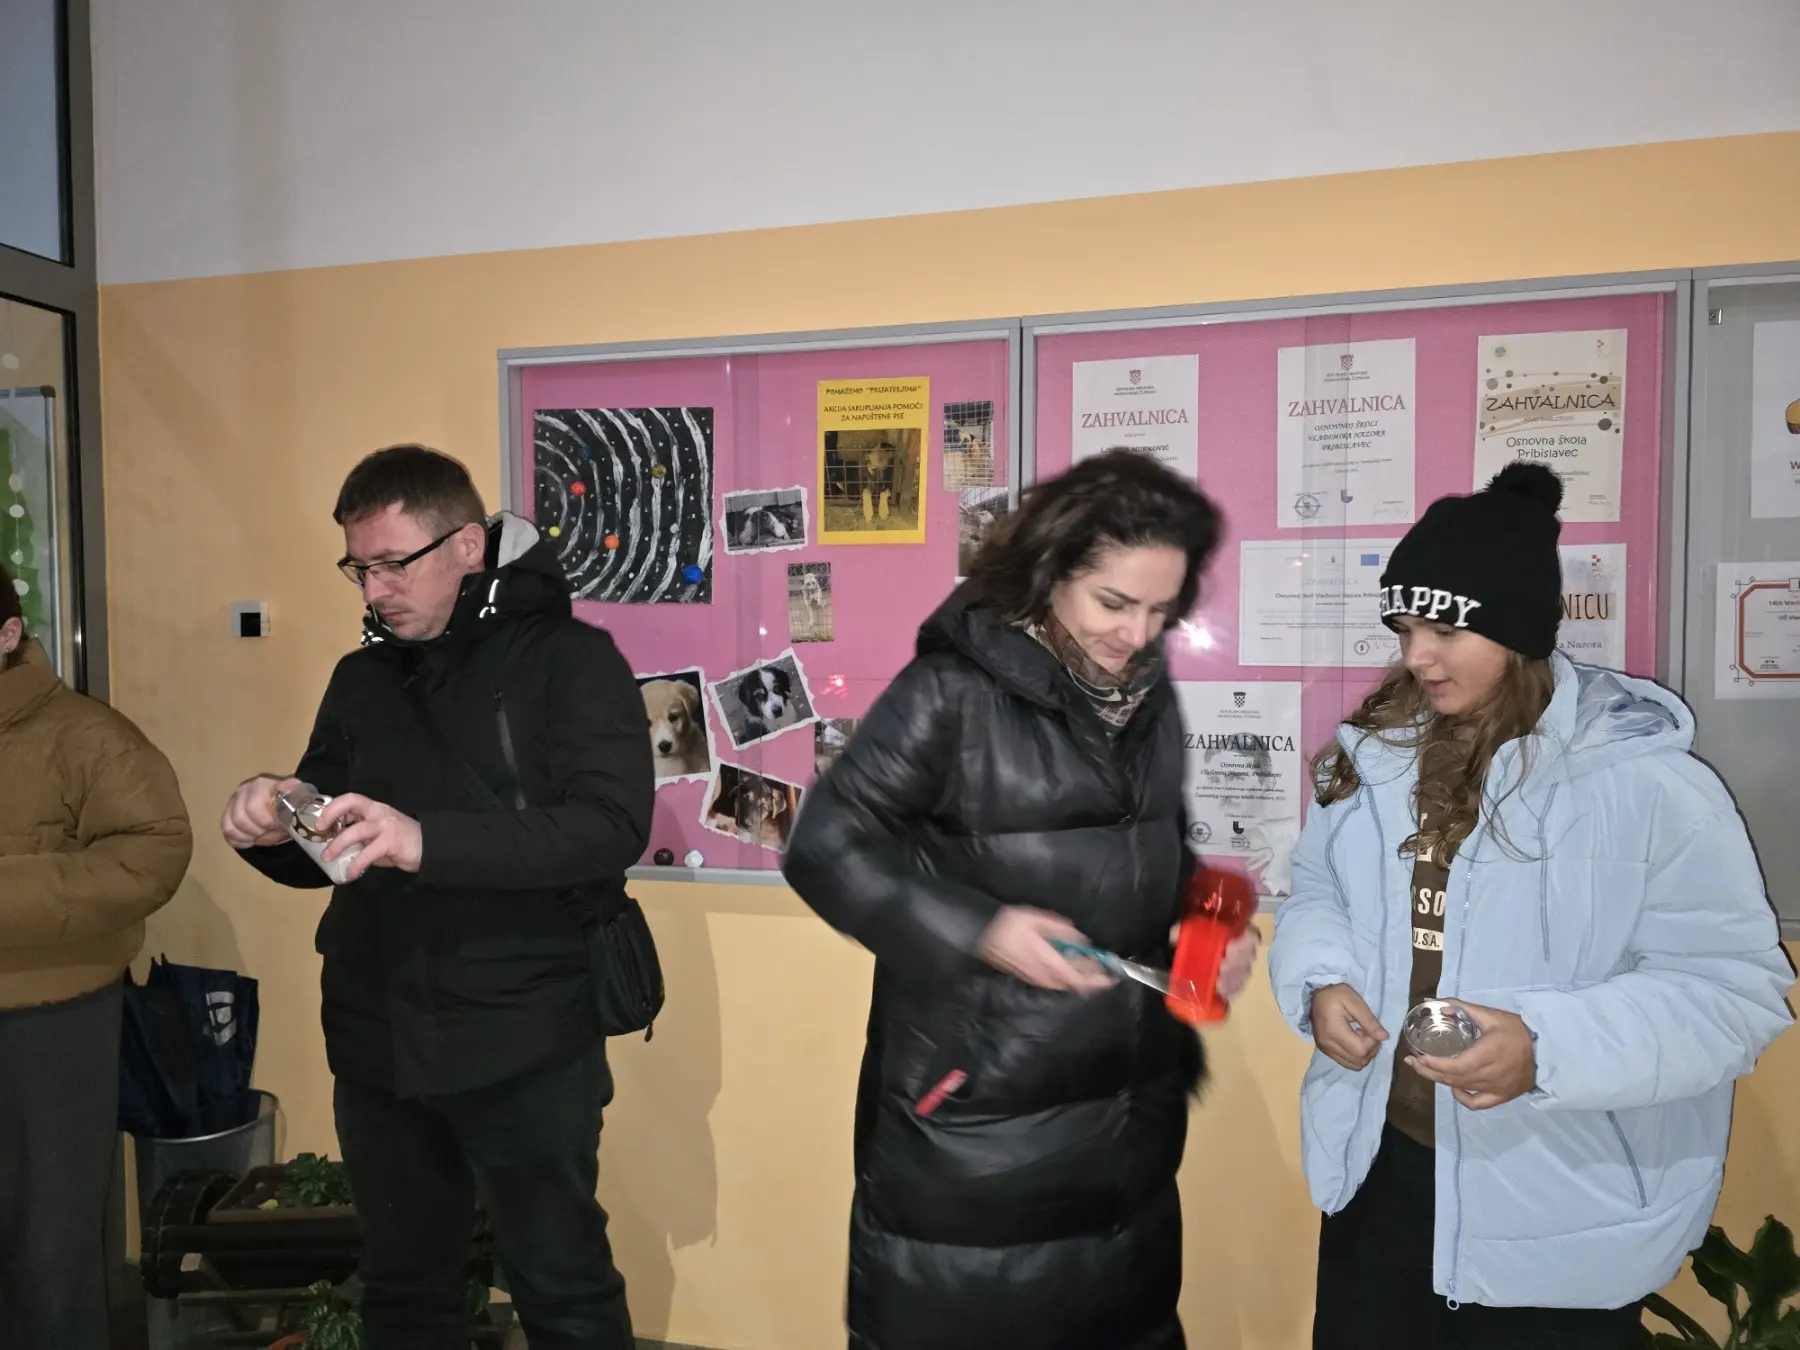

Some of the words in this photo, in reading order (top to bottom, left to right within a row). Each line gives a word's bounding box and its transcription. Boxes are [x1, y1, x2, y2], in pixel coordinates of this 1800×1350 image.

[848, 404, 892, 412] SAKUPLJANJA
[1287, 394, 1406, 417] ZAHVALNICA
[1486, 393, 1616, 412] ZAHVALNICA
[852, 412, 891, 421] NAPUŠTENE
[893, 412, 905, 420] PSE
[1081, 408, 1189, 429] ZAHVALNICA
[1506, 437, 1555, 448] Osnovna
[1558, 435, 1587, 445] škola
[1517, 448, 1579, 460] Pribislavec
[1380, 584, 1482, 628] HAPPY
[1567, 640, 1603, 649] Nazora
[1184, 733, 1295, 752] ZAHVALNICA
